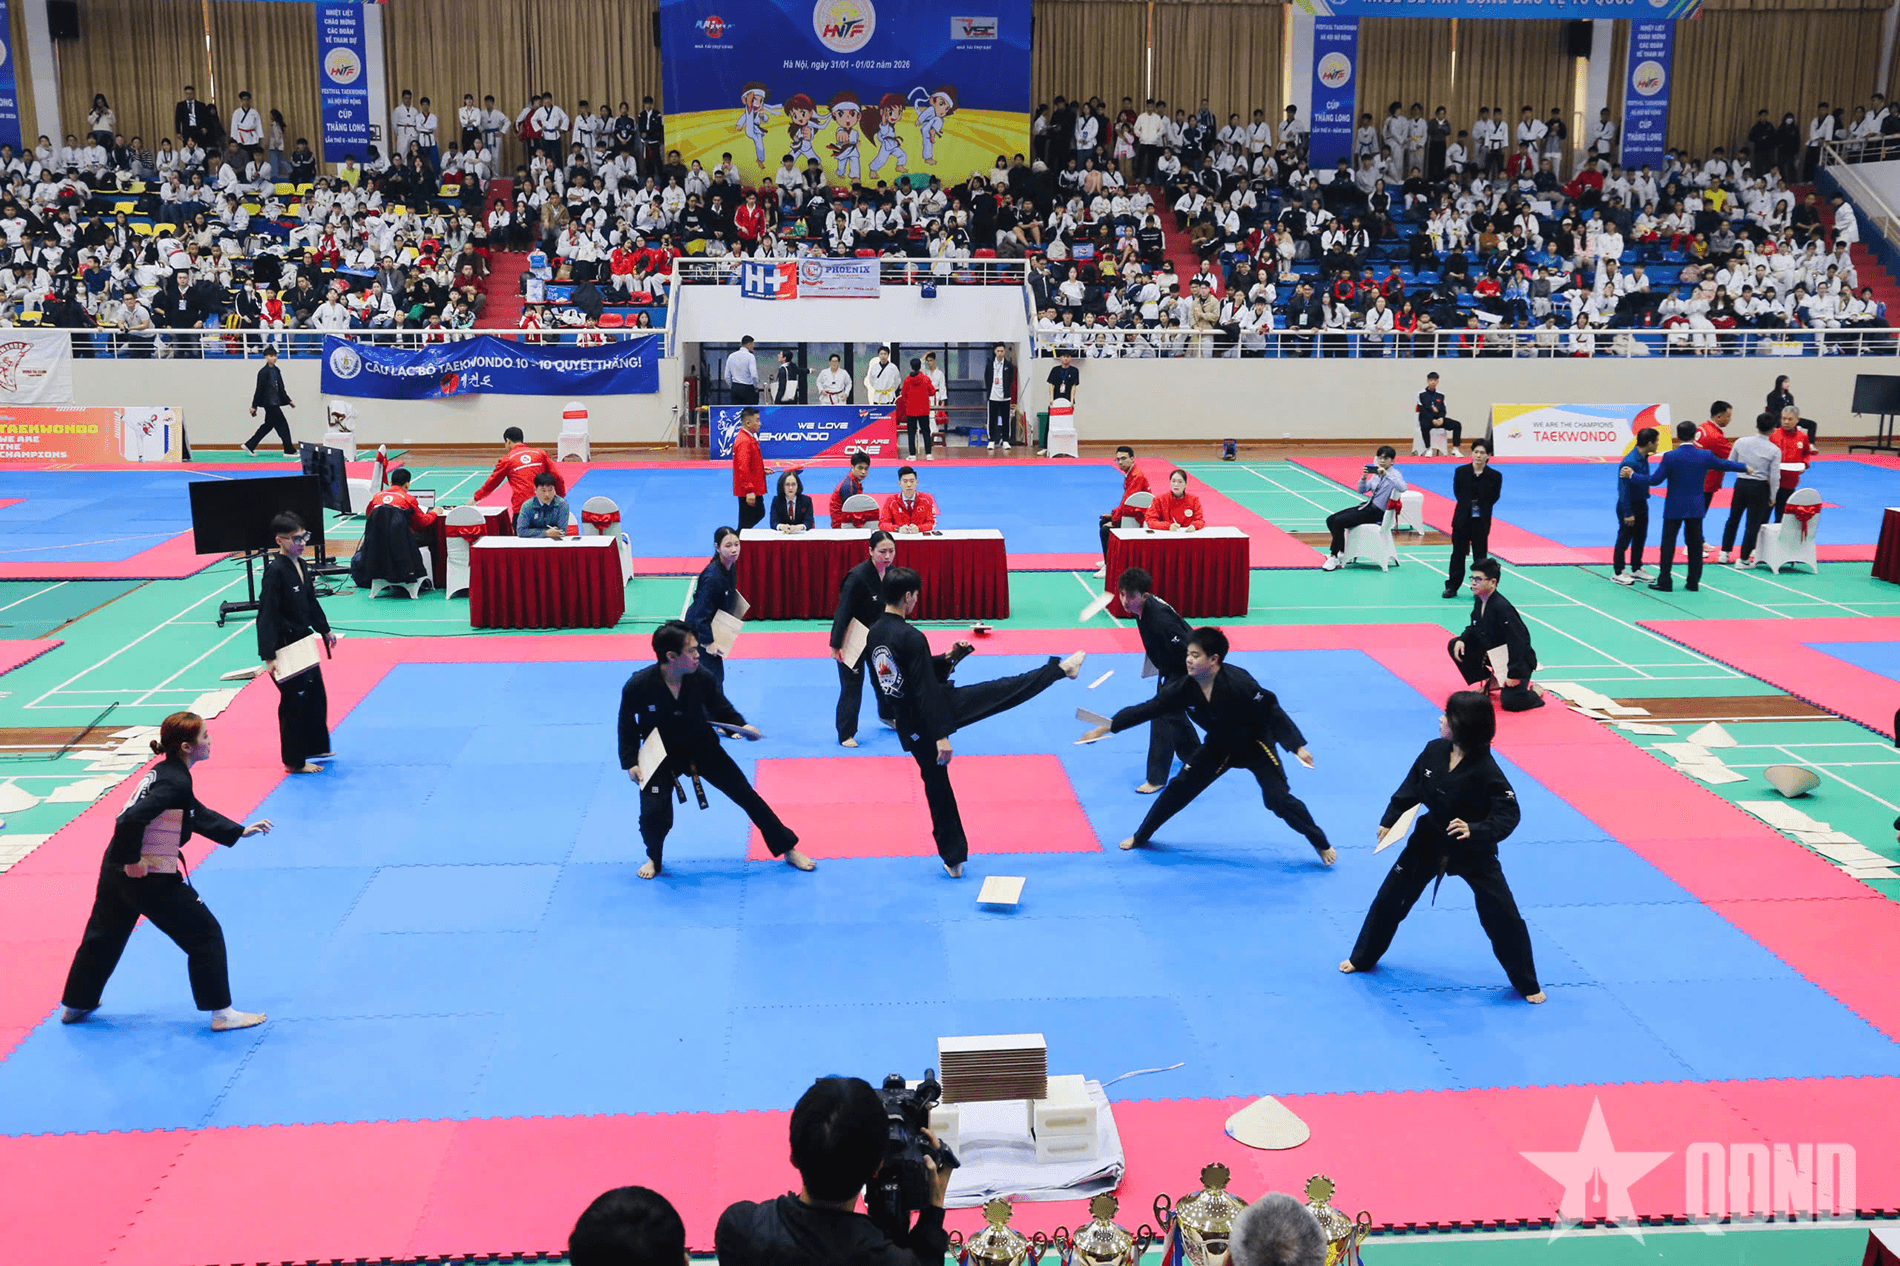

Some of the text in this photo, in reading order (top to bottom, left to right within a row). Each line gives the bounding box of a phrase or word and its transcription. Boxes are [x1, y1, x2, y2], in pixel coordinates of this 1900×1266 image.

[783, 60, 793, 68] Hà
[795, 60, 809, 70] Nội,
[811, 60, 829, 70] ngày
[830, 60, 849, 69] 31/01
[856, 60, 874, 69] 01/02
[876, 60, 892, 69] năm
[893, 60, 910, 69] 2026
[338, 108, 352, 118] CÚP
[349, 124, 366, 132] LONG
[825, 266, 870, 274] PHOENIX
[365, 361, 388, 375] CÂU
[391, 368, 414, 380] LẠC
[418, 363, 436, 378] BỘ
[439, 356, 512, 374] TAEKWONDO
[516, 358, 528, 368] 10
[538, 360, 551, 370] 10
[0, 425, 99, 433] TAEKWONDO
[798, 422, 848, 430] WE LOVE
[1533, 431, 1617, 442] TAEKWONDO
[844, 446, 881, 455] ONE
